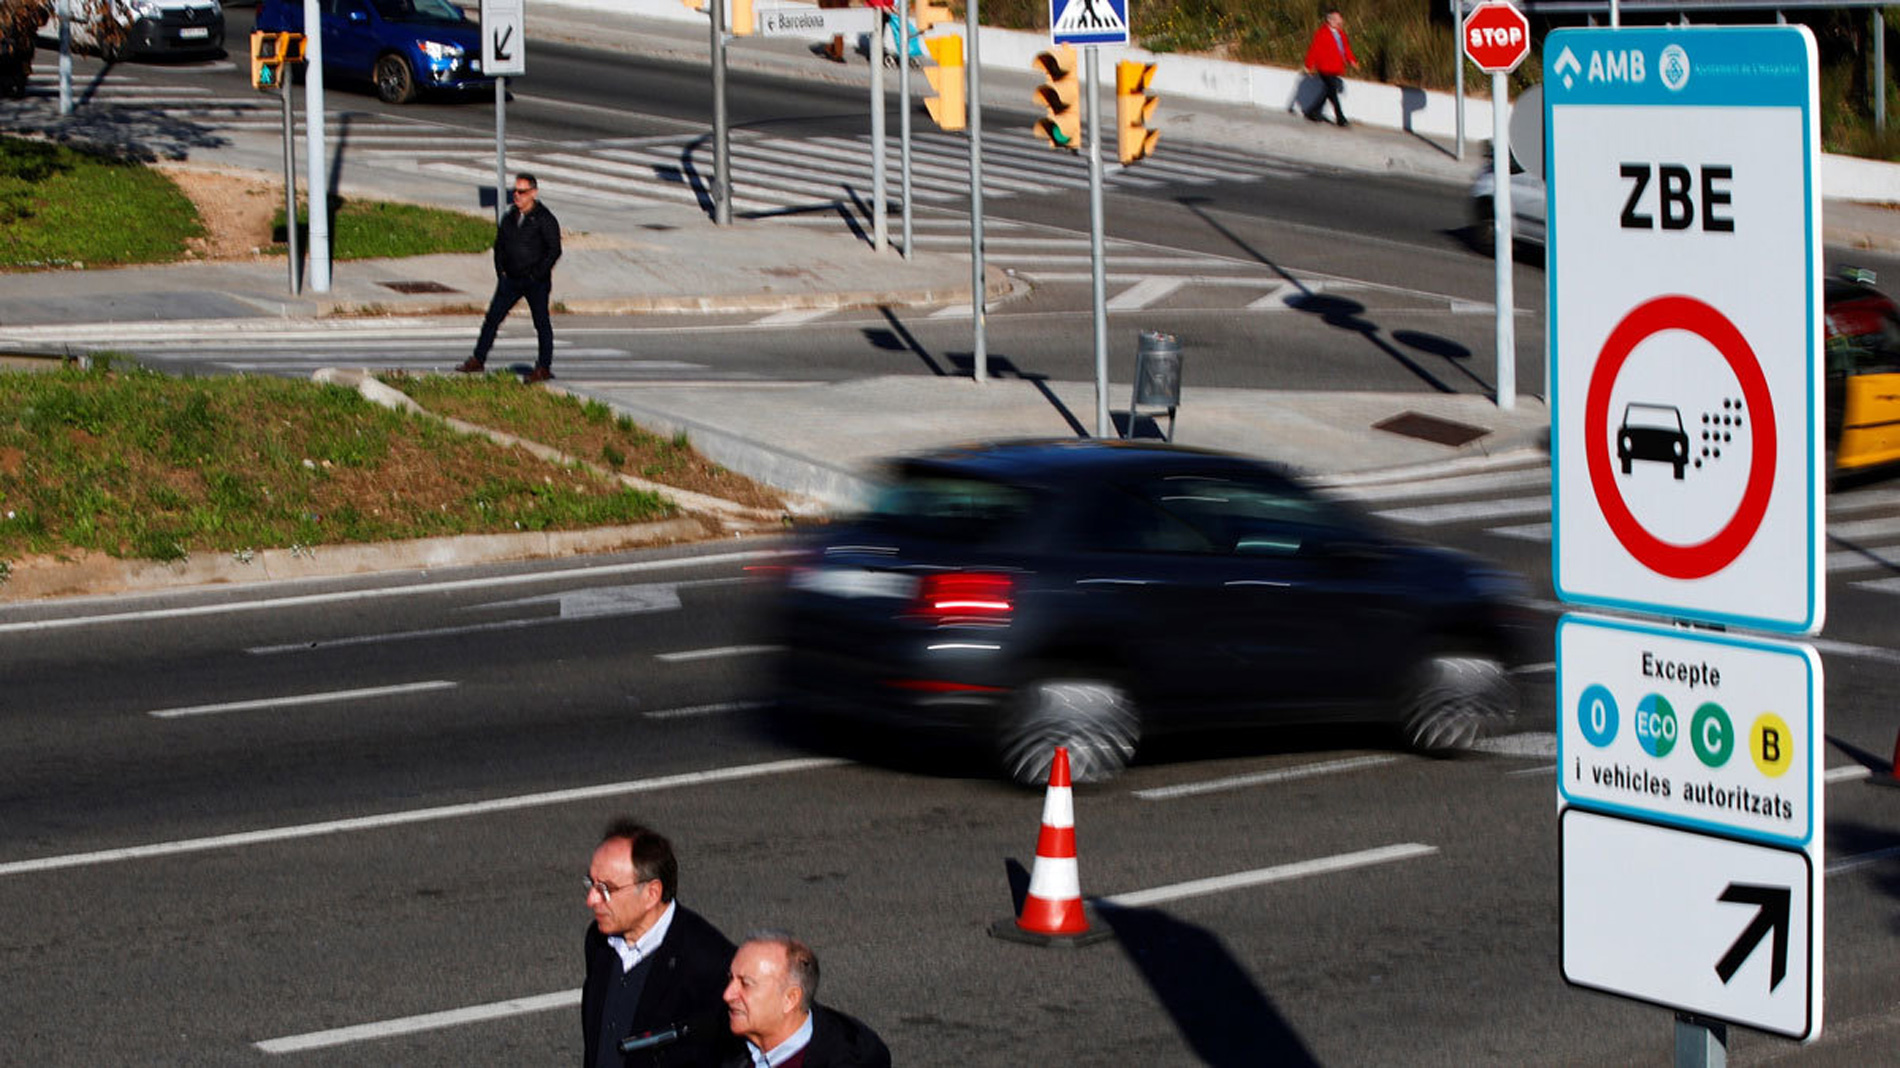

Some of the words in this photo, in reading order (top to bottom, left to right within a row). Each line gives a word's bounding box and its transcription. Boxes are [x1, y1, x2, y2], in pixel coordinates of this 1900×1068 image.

[778, 12, 823, 29] Barcelona
[1469, 26, 1522, 46] STOP
[1588, 49, 1646, 84] AMB
[1620, 163, 1735, 233] ZBE
[1642, 652, 1721, 688] Excepte
[1637, 711, 1676, 740] ECO
[1702, 720, 1722, 753] C
[1761, 726, 1780, 762] B
[1576, 757, 1581, 780] i
[1592, 763, 1671, 797] vehicles
[1683, 780, 1793, 820] autoritzats
